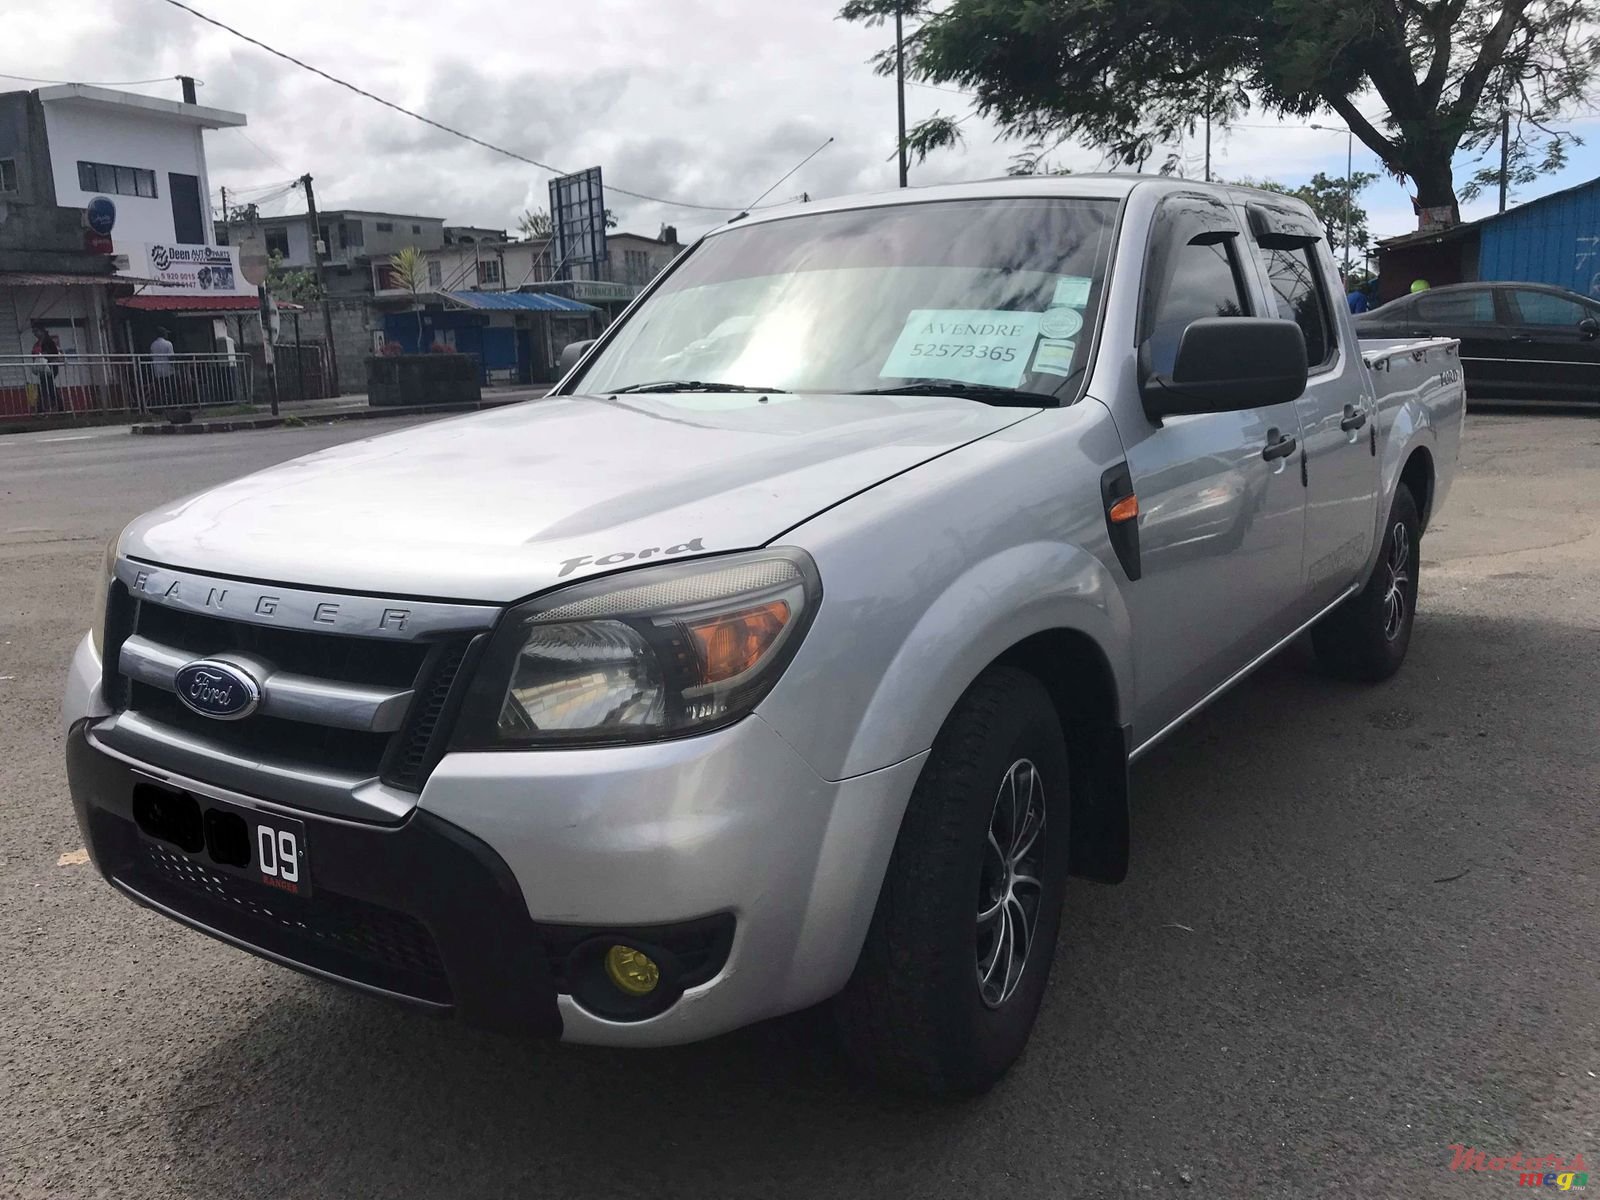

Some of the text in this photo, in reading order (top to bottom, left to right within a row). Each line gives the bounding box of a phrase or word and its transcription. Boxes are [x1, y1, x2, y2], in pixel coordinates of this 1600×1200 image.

[169, 247, 190, 260] Deen
[909, 343, 1017, 362] 52573365
[558, 537, 706, 578] Ford
[132, 570, 412, 631] RANGER
[189, 671, 232, 706] Ford
[257, 824, 299, 883] 09
